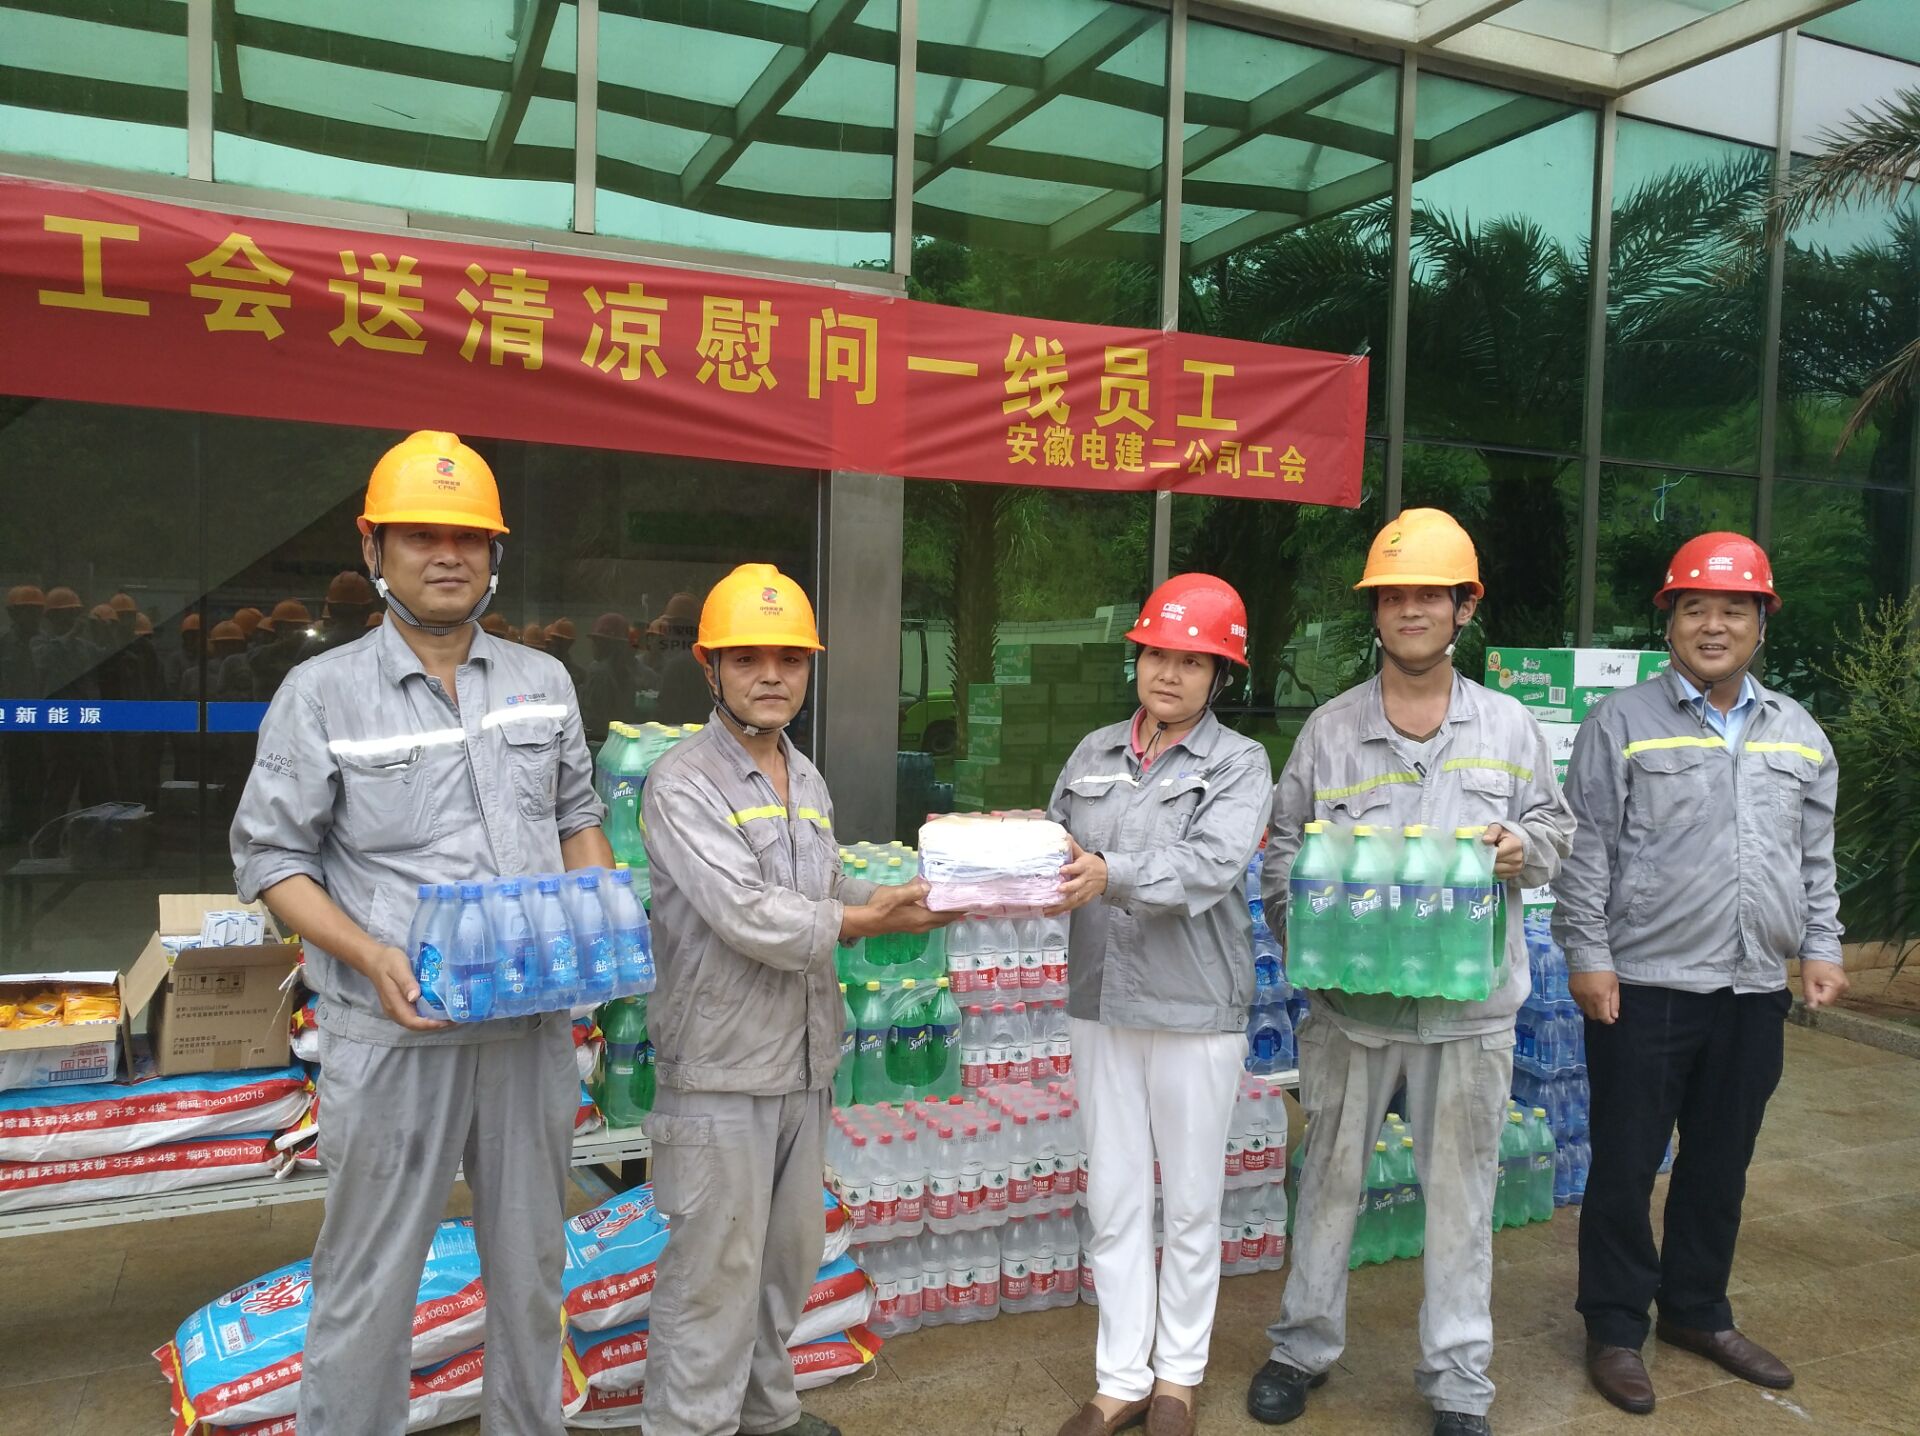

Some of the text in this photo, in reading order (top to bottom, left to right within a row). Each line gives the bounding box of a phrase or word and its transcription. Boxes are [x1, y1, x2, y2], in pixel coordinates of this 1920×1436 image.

[39, 215, 1238, 431] 工会送清凉慰问一线员工
[1006, 421, 1307, 485] 安徽电建二公司工会
